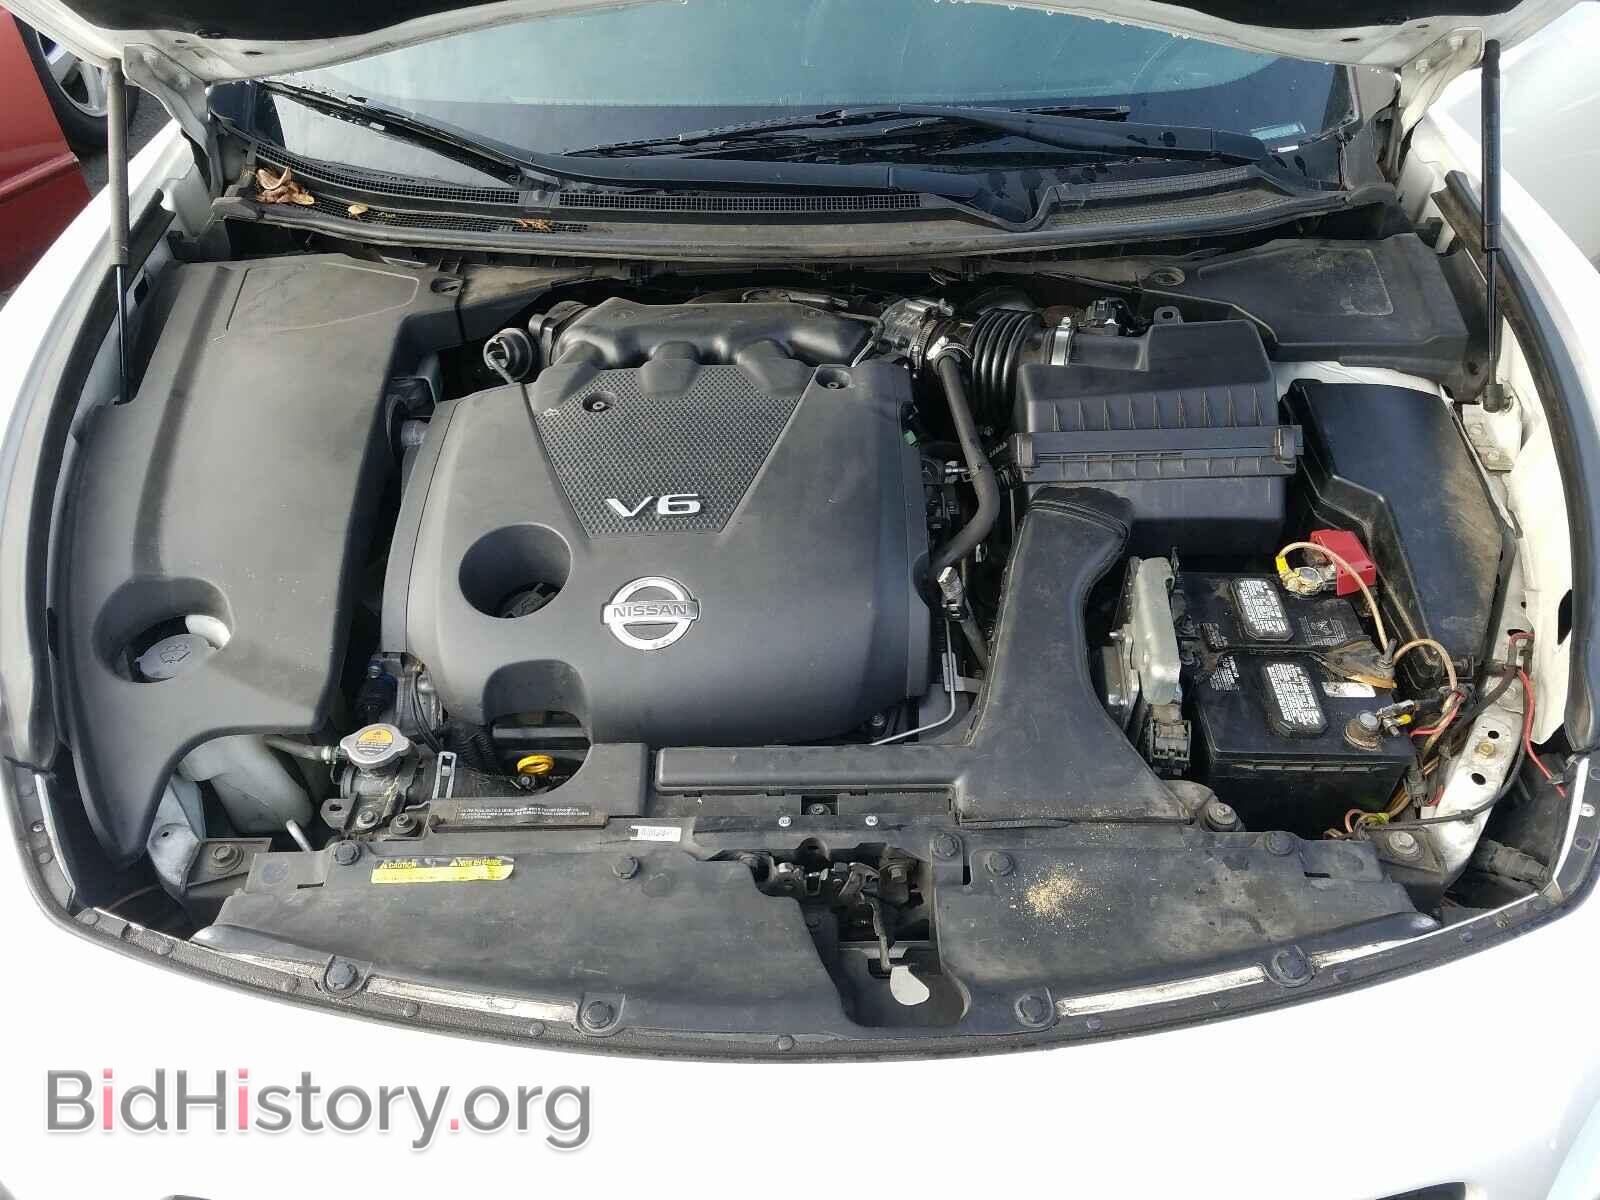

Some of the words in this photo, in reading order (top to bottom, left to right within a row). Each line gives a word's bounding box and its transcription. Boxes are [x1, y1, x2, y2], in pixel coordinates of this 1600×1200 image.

[605, 493, 701, 518] V6
[613, 604, 688, 618] NISSAN
[388, 861, 417, 870] CAUTION
